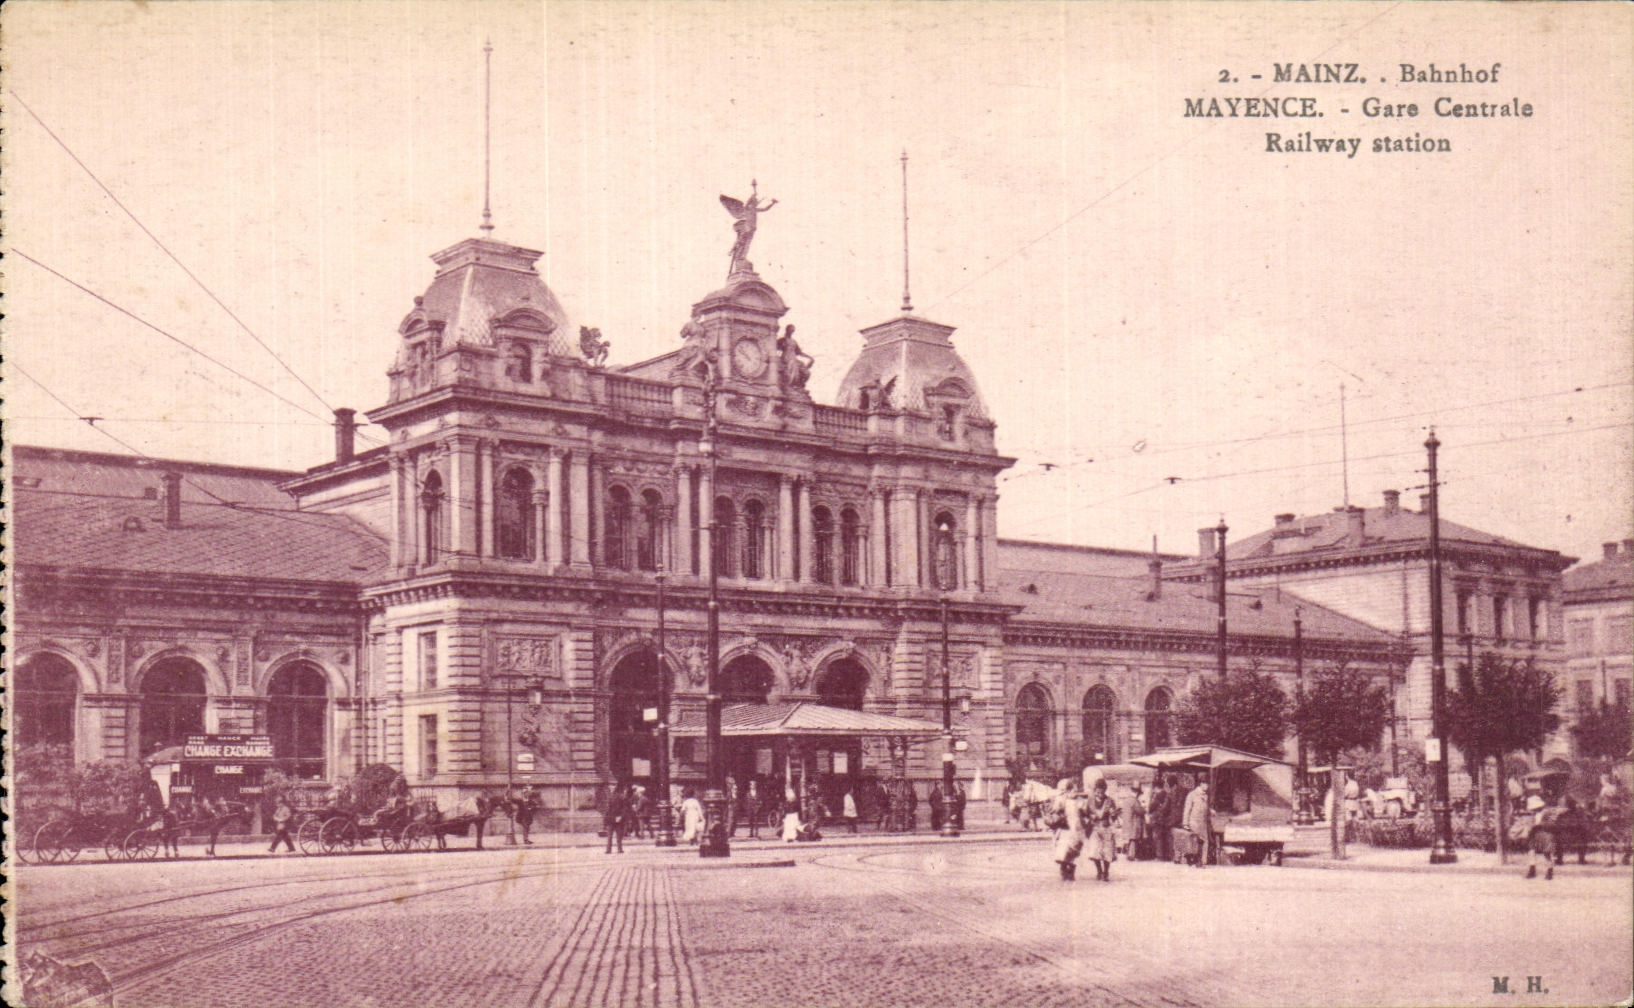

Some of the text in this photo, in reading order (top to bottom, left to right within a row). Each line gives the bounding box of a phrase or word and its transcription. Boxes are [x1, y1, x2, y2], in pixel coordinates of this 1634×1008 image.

[184, 745, 273, 757] CHANGE EXCHANGE
[215, 765, 244, 774] CHANGE
